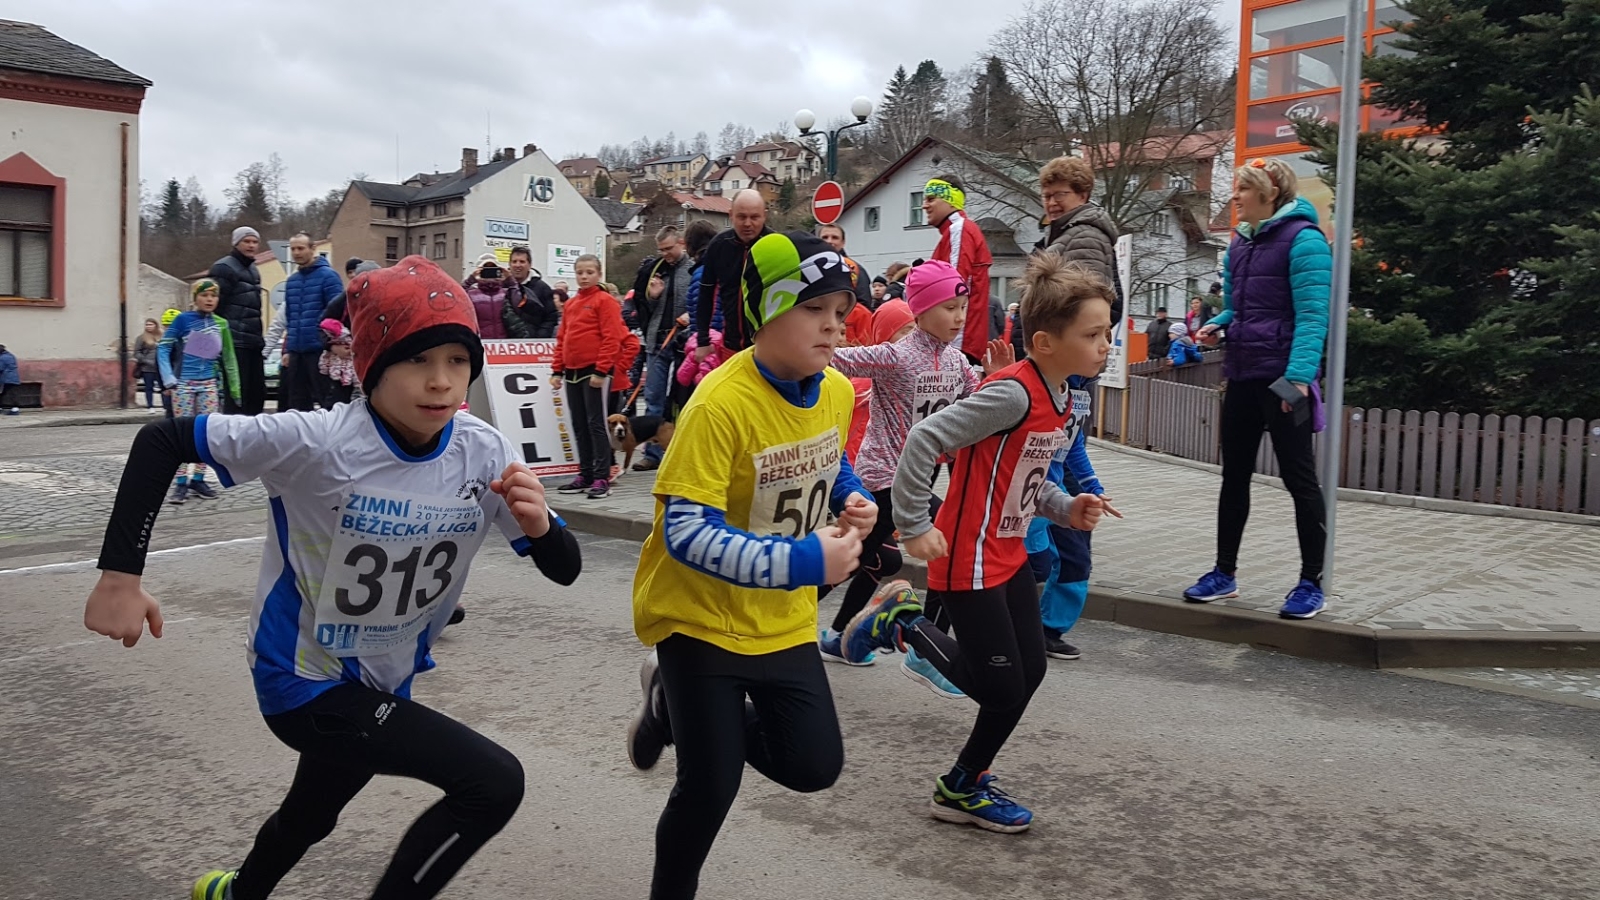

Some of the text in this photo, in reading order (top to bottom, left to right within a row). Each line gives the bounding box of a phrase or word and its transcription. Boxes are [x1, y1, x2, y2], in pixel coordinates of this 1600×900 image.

[917, 383, 955, 394] BĚŽECKÁ
[918, 373, 943, 384] ZIMNÍ
[1028, 433, 1054, 447] ZIMNÍ
[759, 444, 801, 469] ZIMNÍ
[759, 456, 817, 485] BĚŽECKÁ
[821, 448, 840, 468] LIGA
[345, 493, 413, 519] ZIMNÍ
[136, 511, 155, 549] KIPSTA
[340, 513, 477, 537] BĚŽECKÁ LIGA
[334, 540, 459, 617] 313
